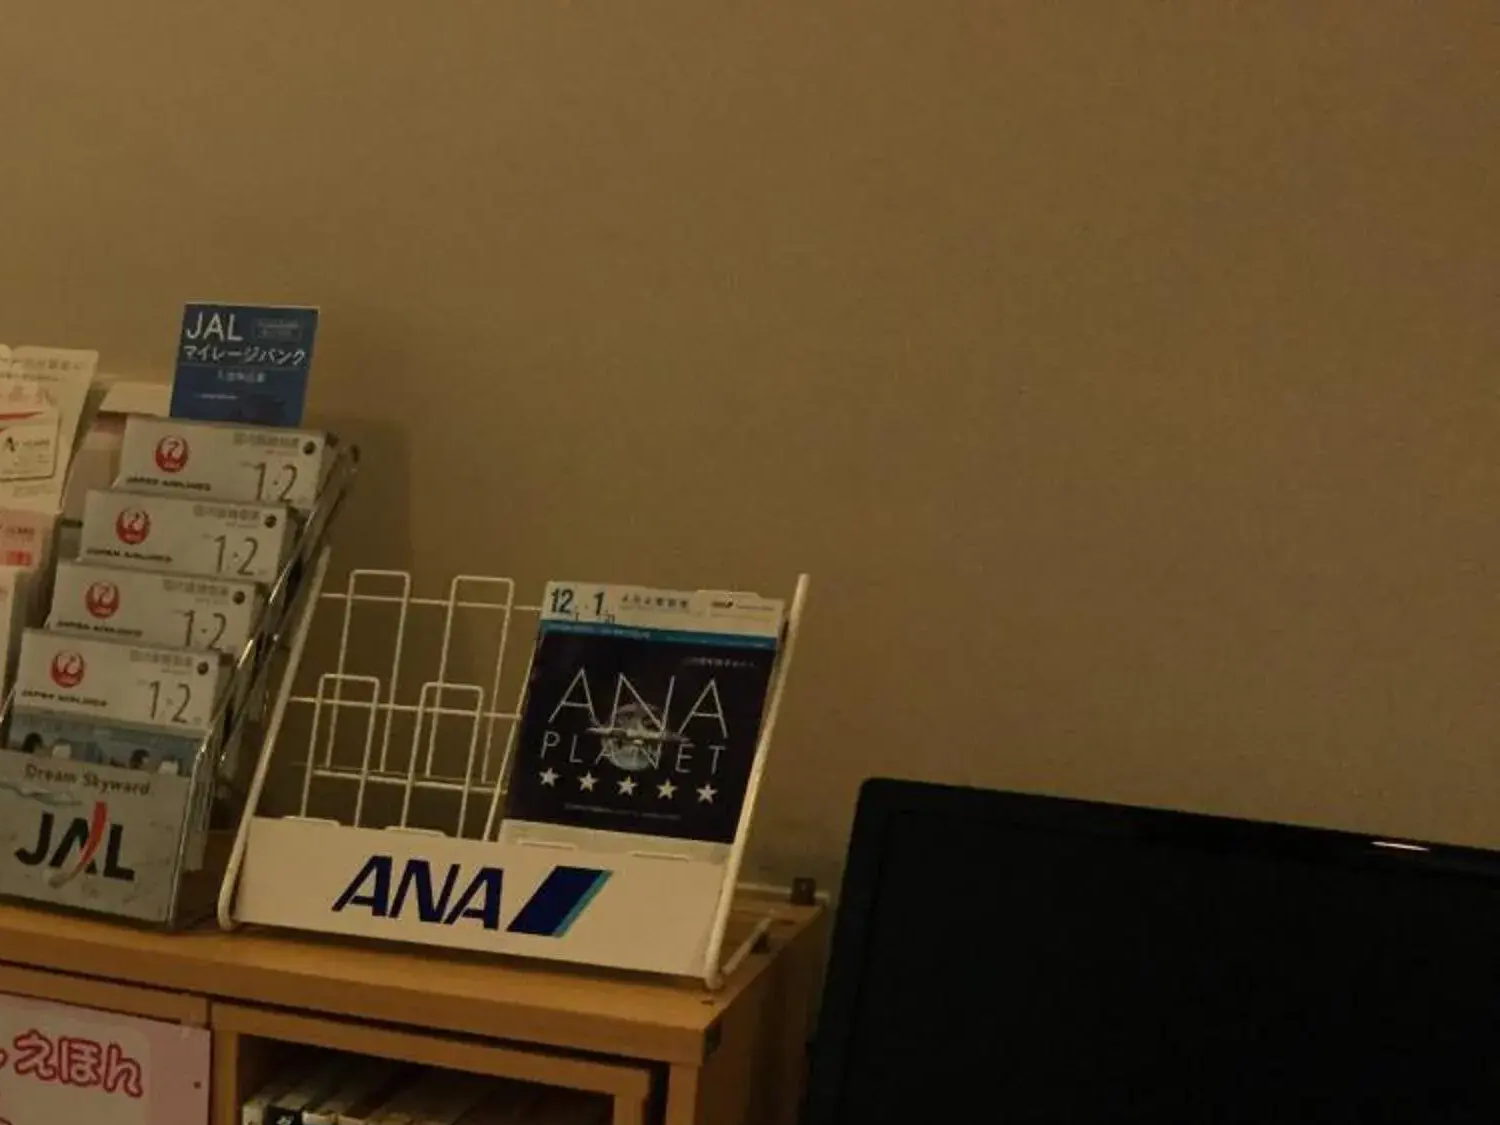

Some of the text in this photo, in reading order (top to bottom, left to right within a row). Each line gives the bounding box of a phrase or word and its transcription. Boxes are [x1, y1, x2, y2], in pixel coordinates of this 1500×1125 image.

[186, 311, 244, 341] JAL
[184, 344, 307, 365] マイレージバンク
[550, 587, 574, 613] 12
[548, 666, 730, 741] ANA
[540, 730, 727, 774] PLANET
[25, 763, 149, 796] Dream Skyward
[13, 804, 136, 886] JAL
[331, 853, 505, 930] ANA
